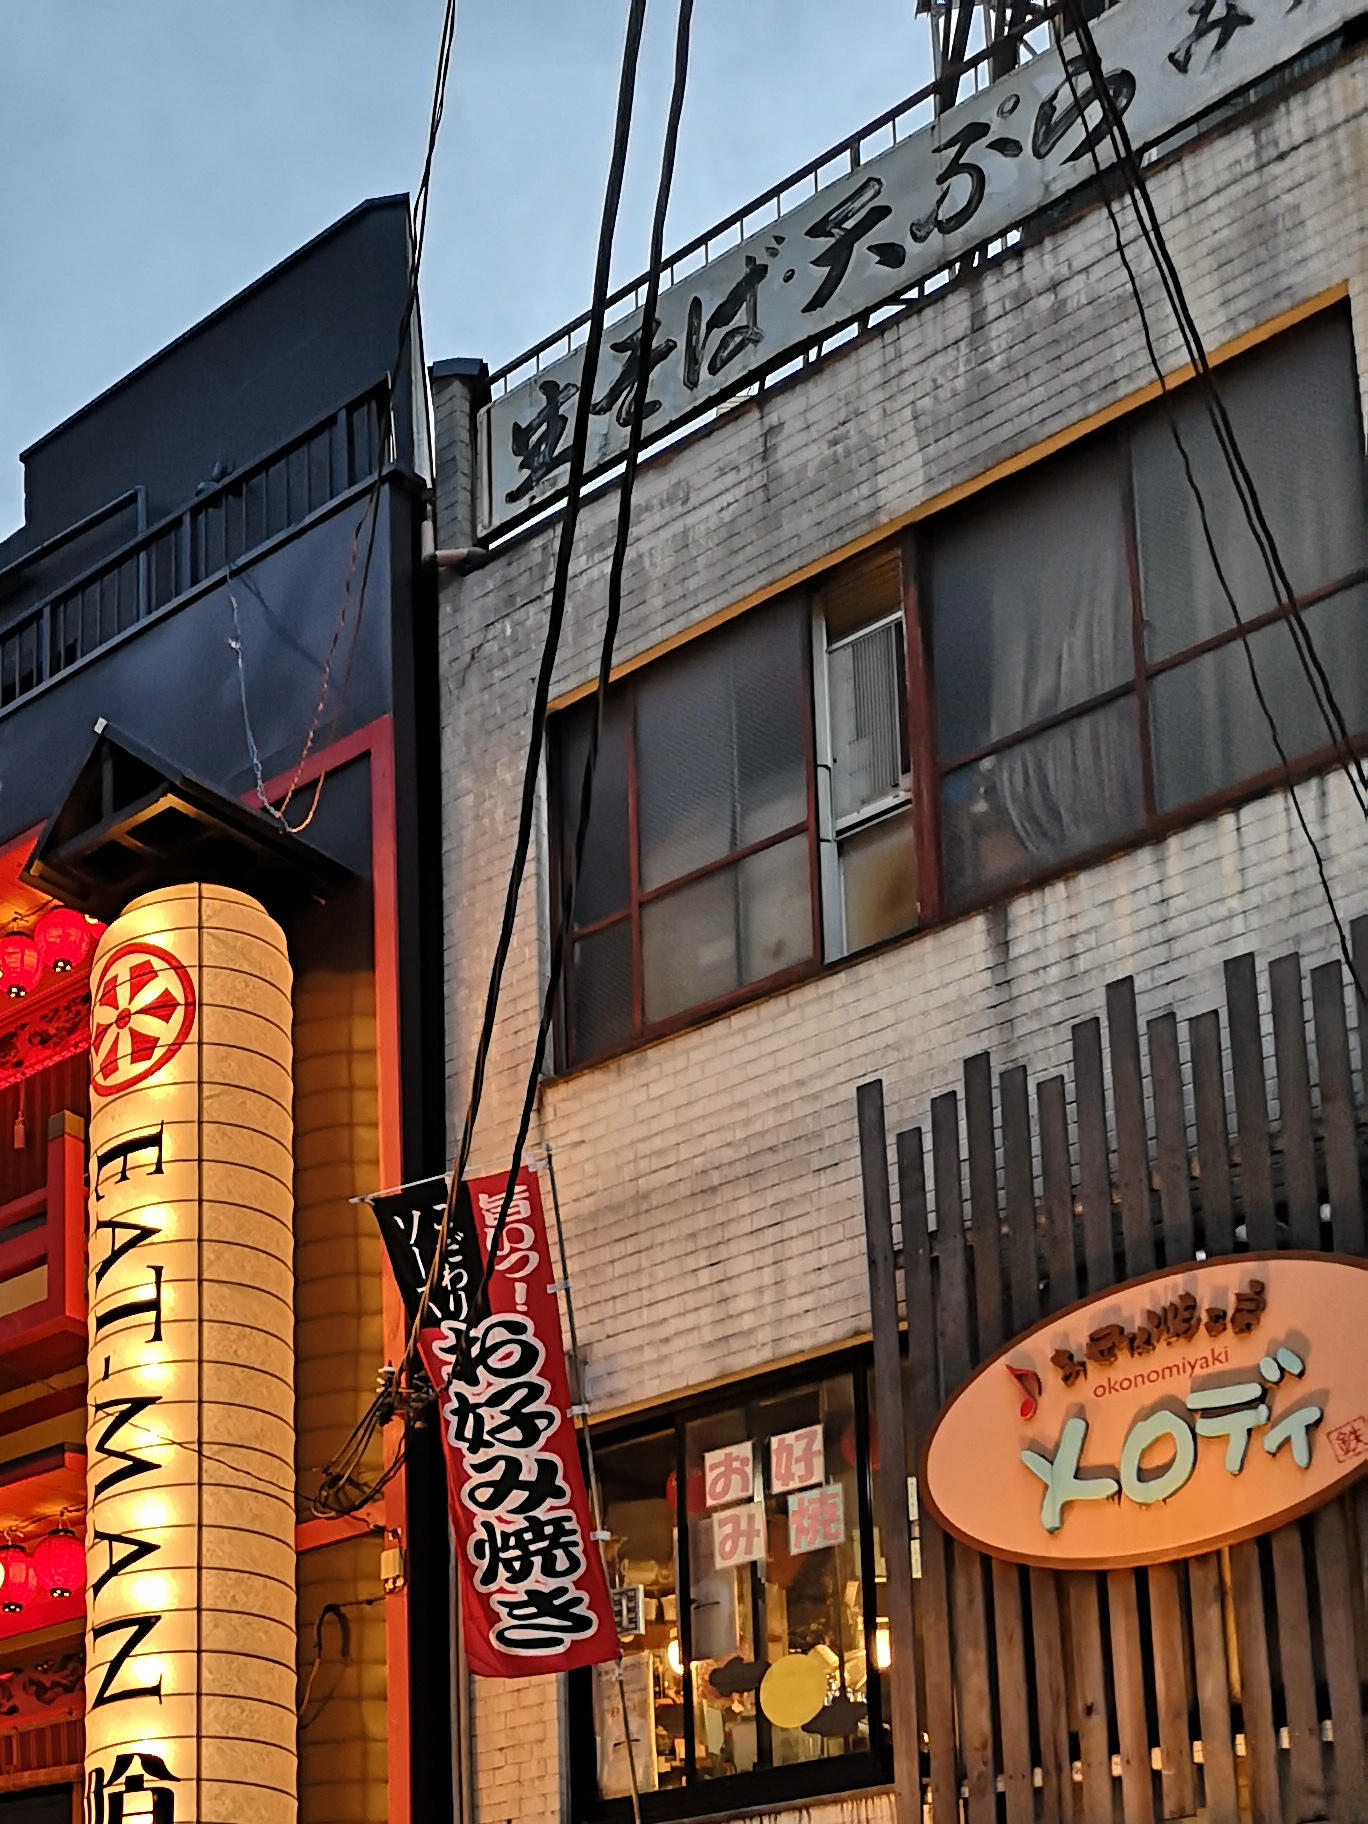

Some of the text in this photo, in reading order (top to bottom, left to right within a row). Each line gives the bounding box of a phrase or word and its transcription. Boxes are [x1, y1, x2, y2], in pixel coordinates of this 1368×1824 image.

[93, 1120, 165, 1706] EAT-MAN
[435, 1317, 596, 1653] お好み焼き
[1020, 1347, 1323, 1533] メロディ
[1093, 1346, 1230, 1398] okonomiyaki
